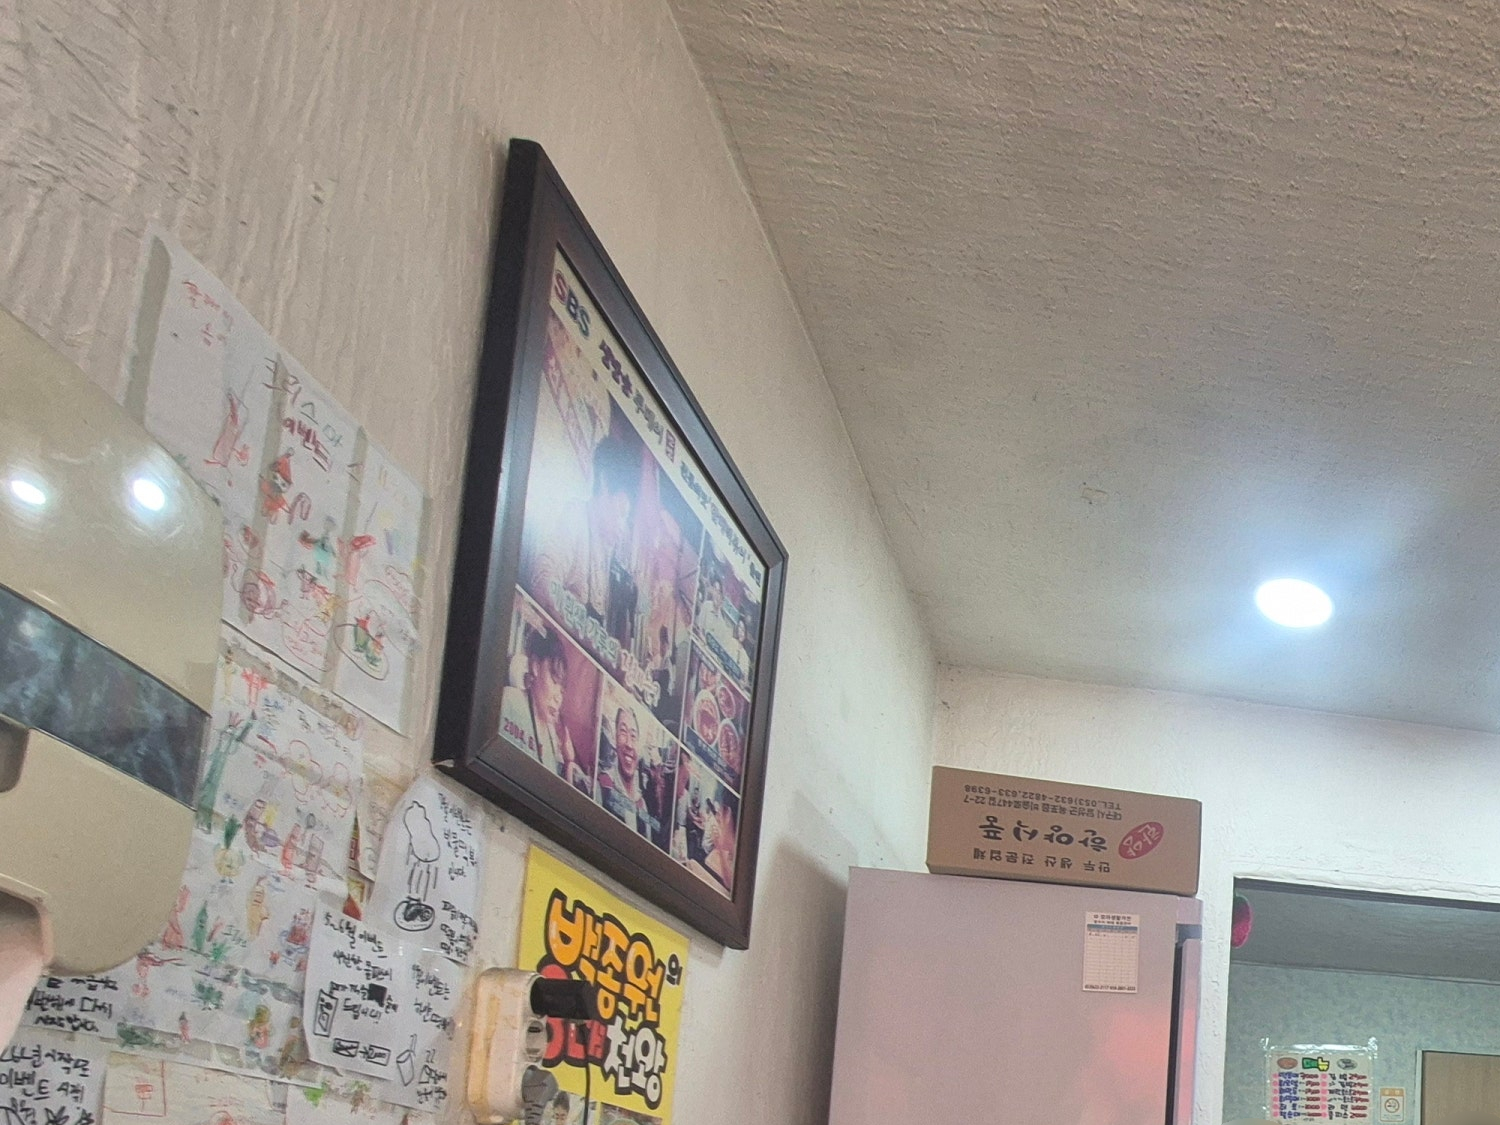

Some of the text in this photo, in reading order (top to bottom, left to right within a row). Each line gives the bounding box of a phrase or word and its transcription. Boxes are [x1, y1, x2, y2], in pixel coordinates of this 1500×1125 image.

[555, 270, 591, 338] SBS
[979, 815, 1107, 852] 한양식품
[973, 848, 1111, 873] 만두 생산 전문업체
